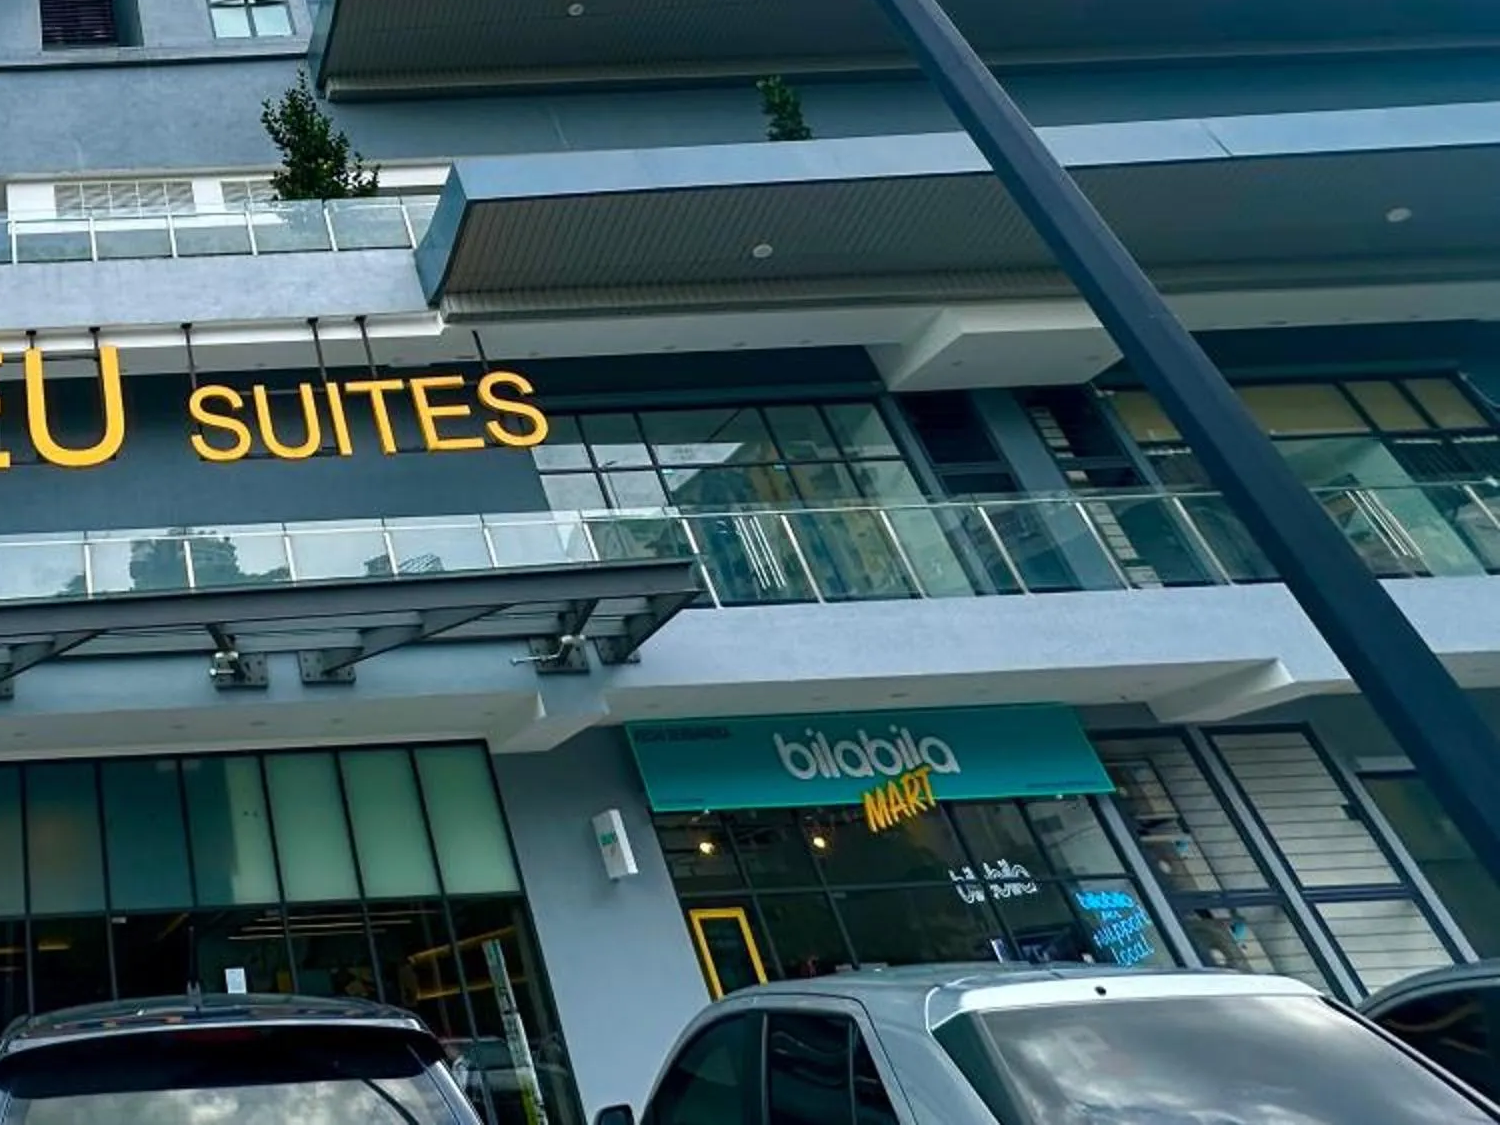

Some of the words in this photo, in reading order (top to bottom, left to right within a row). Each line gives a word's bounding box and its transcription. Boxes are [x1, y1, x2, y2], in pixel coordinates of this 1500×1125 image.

[188, 371, 549, 462] SUITES
[773, 724, 962, 780] bilabila
[863, 763, 936, 833] MART
